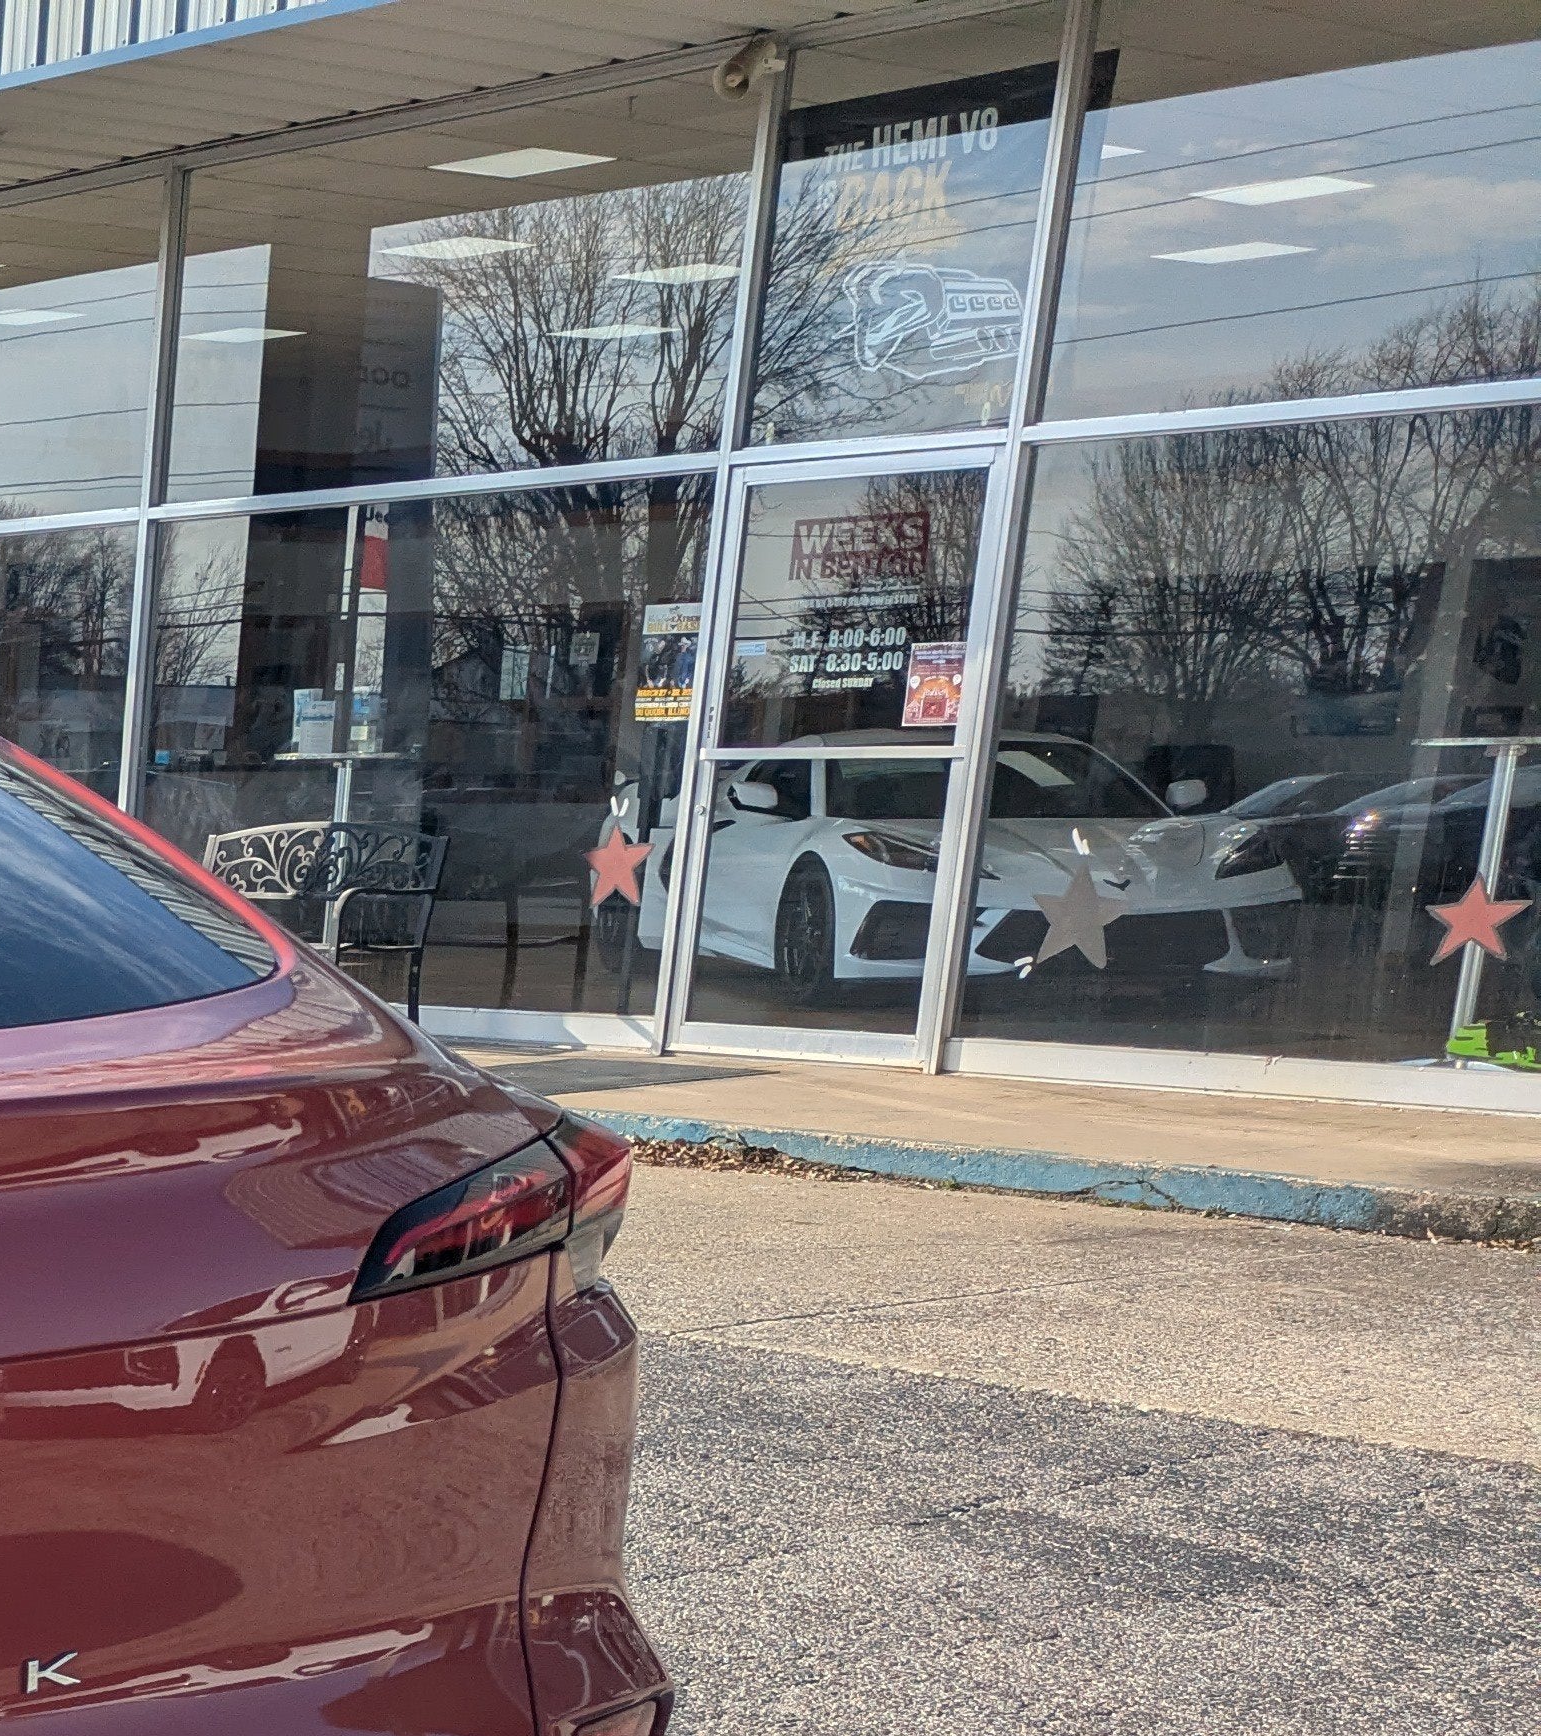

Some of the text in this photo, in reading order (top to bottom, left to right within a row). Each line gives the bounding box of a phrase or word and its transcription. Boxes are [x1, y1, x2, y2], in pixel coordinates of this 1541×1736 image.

[824, 107, 999, 174] THE HEMI V8
[799, 517, 925, 554] WEEKS
[828, 626, 907, 648] 8:00-6:00
[789, 653, 817, 673] SAT
[825, 651, 904, 672] 8:30-5:00
[812, 677, 874, 689] Closed SUNDAY
